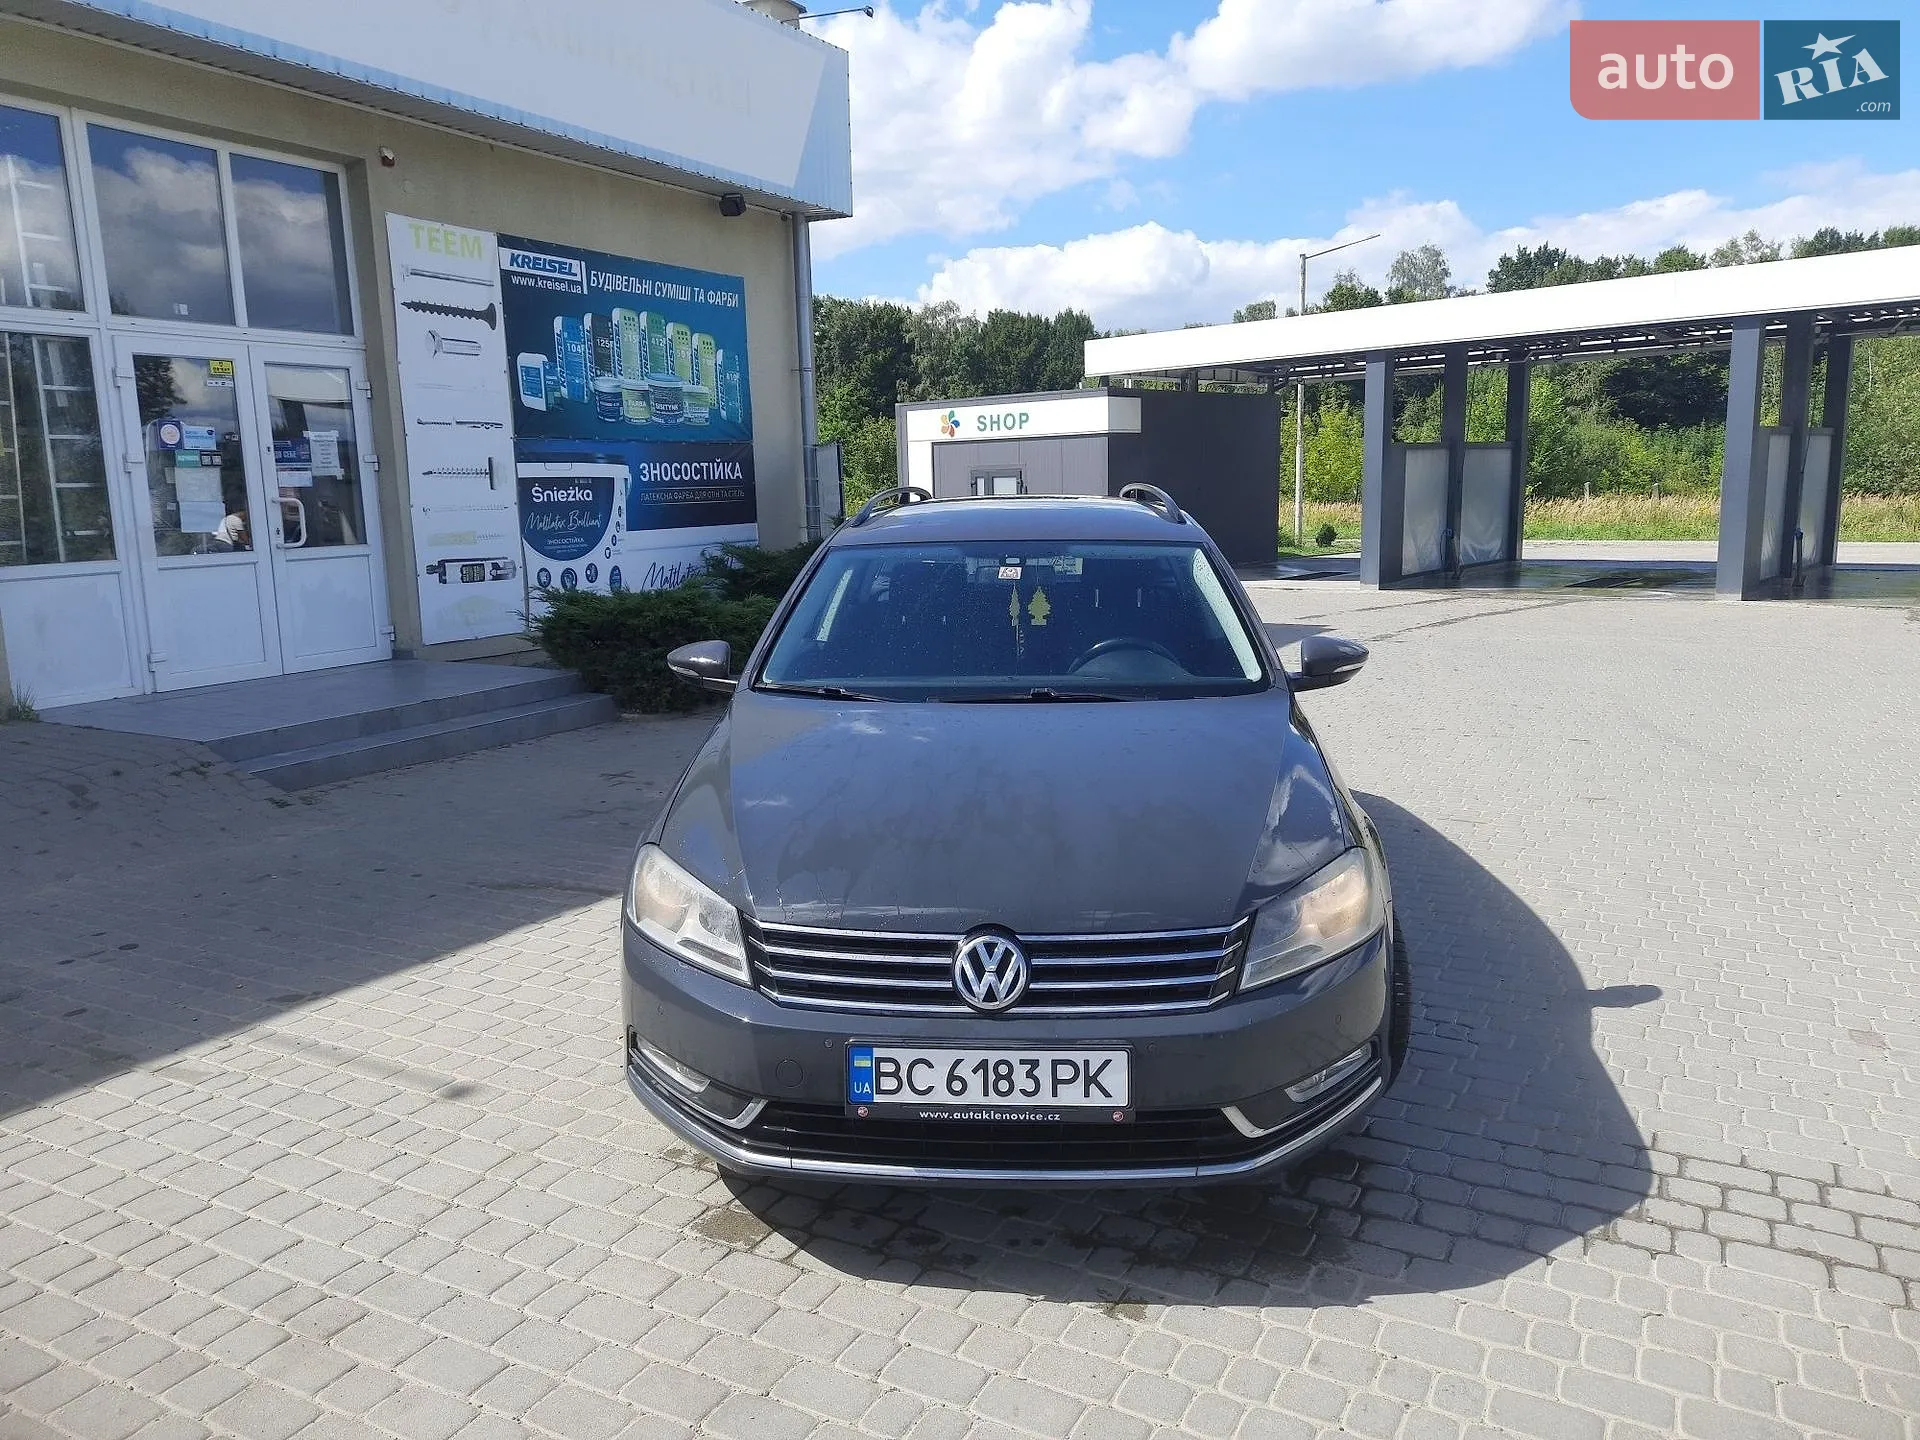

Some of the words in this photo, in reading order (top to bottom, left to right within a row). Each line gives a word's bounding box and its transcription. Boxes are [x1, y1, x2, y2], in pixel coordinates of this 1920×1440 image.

[409, 222, 482, 260] TEEM
[510, 252, 578, 277] KREISEL
[511, 274, 582, 294] www.kreisel.ua
[590, 270, 652, 296] БУДІВЕЛЬНІ
[654, 281, 691, 302] СУМІШІ
[694, 287, 705, 304] ТА
[707, 292, 739, 308] ФАРБИ
[556, 330, 567, 389] KREISEL
[976, 412, 1030, 432] SHOP
[639, 457, 743, 482] ЗНОСОСТІЙКА
[531, 483, 593, 503] Śnieżka
[854, 1081, 871, 1095] UA
[875, 1056, 935, 1097] BC
[946, 1057, 1042, 1098] 6183
[1051, 1058, 1114, 1099] PK
[919, 1109, 1061, 1122] www.autaklenovice.cz
